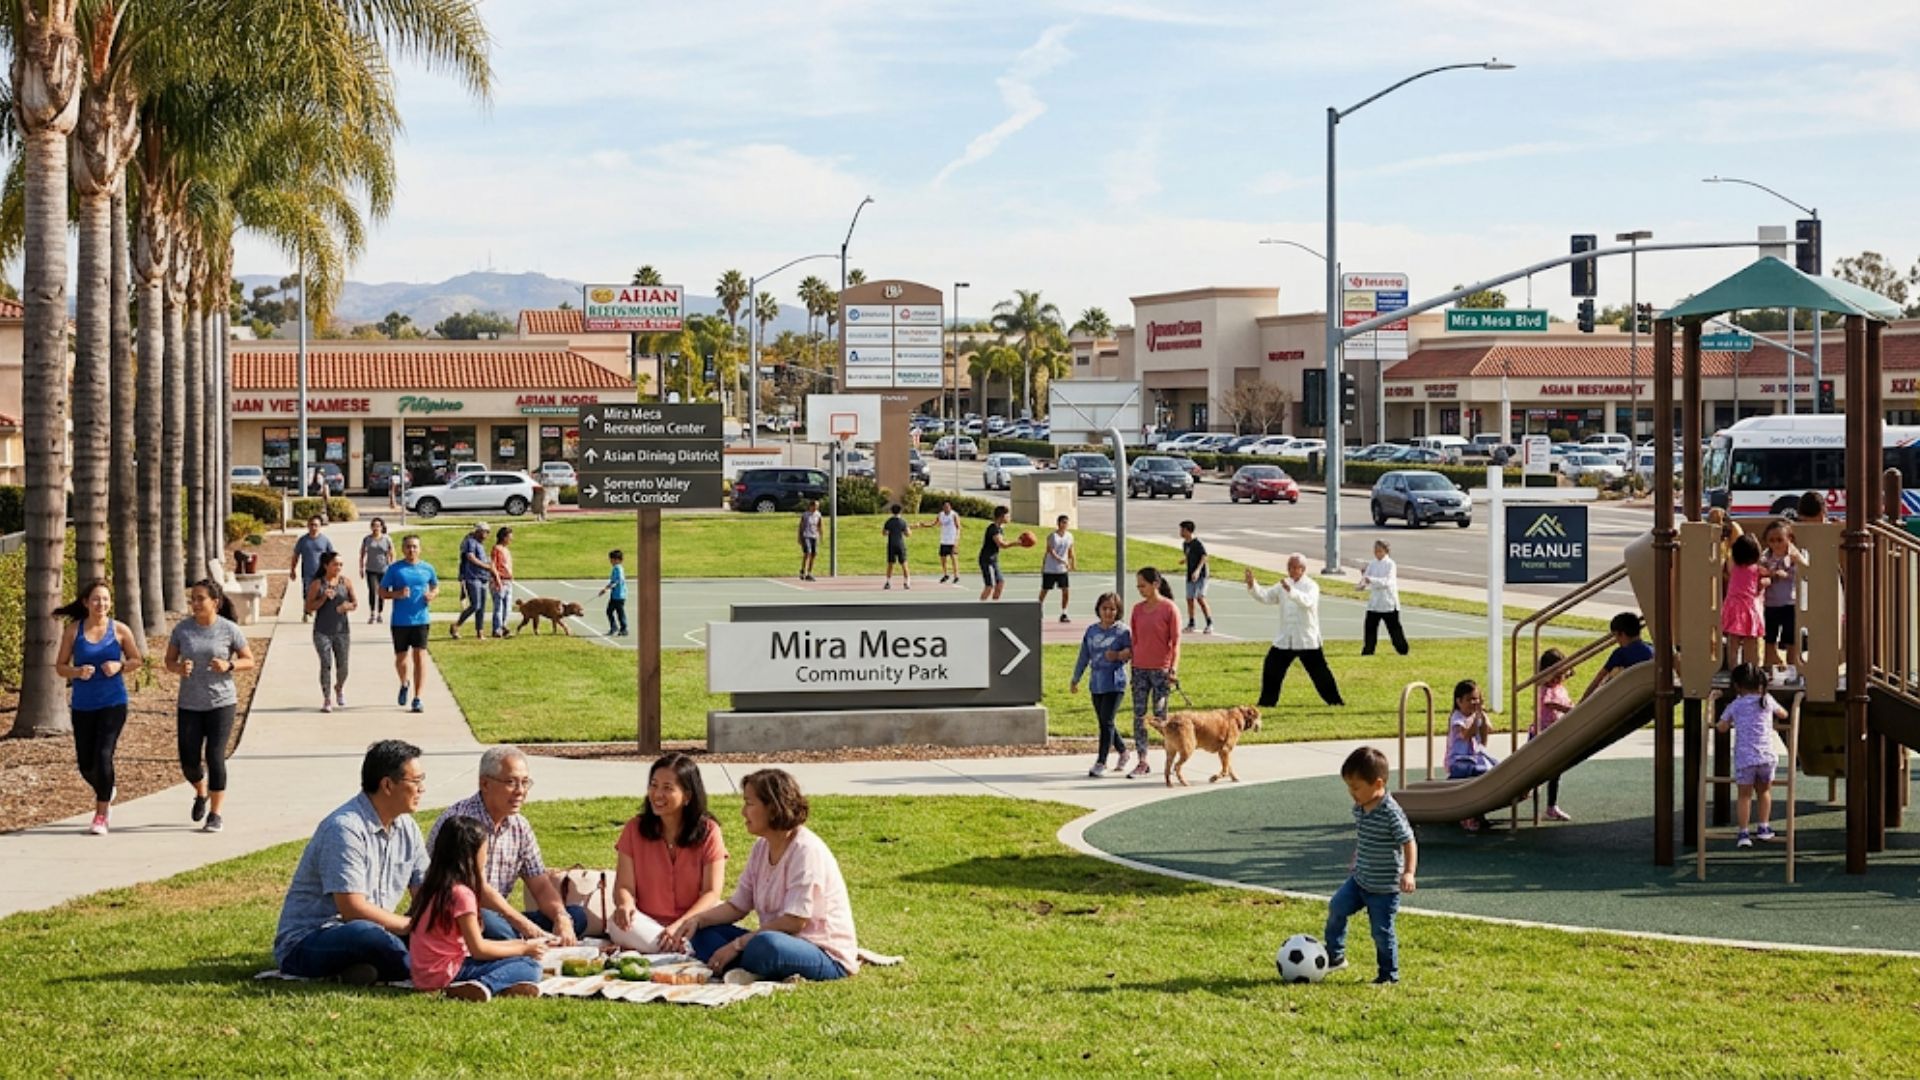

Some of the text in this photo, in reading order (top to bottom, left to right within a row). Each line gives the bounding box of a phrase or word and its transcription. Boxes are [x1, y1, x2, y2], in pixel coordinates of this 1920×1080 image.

[1451, 314, 1542, 327] Mira Mesa Blvd
[666, 422, 706, 434] Center
[603, 450, 636, 462] Asian
[637, 450, 676, 465] Dining
[603, 477, 654, 490] Sorrento
[603, 492, 630, 503] Tech
[1509, 542, 1582, 558] REANUE
[770, 629, 948, 659] Mira Mesa
[795, 663, 949, 684] Community Park
